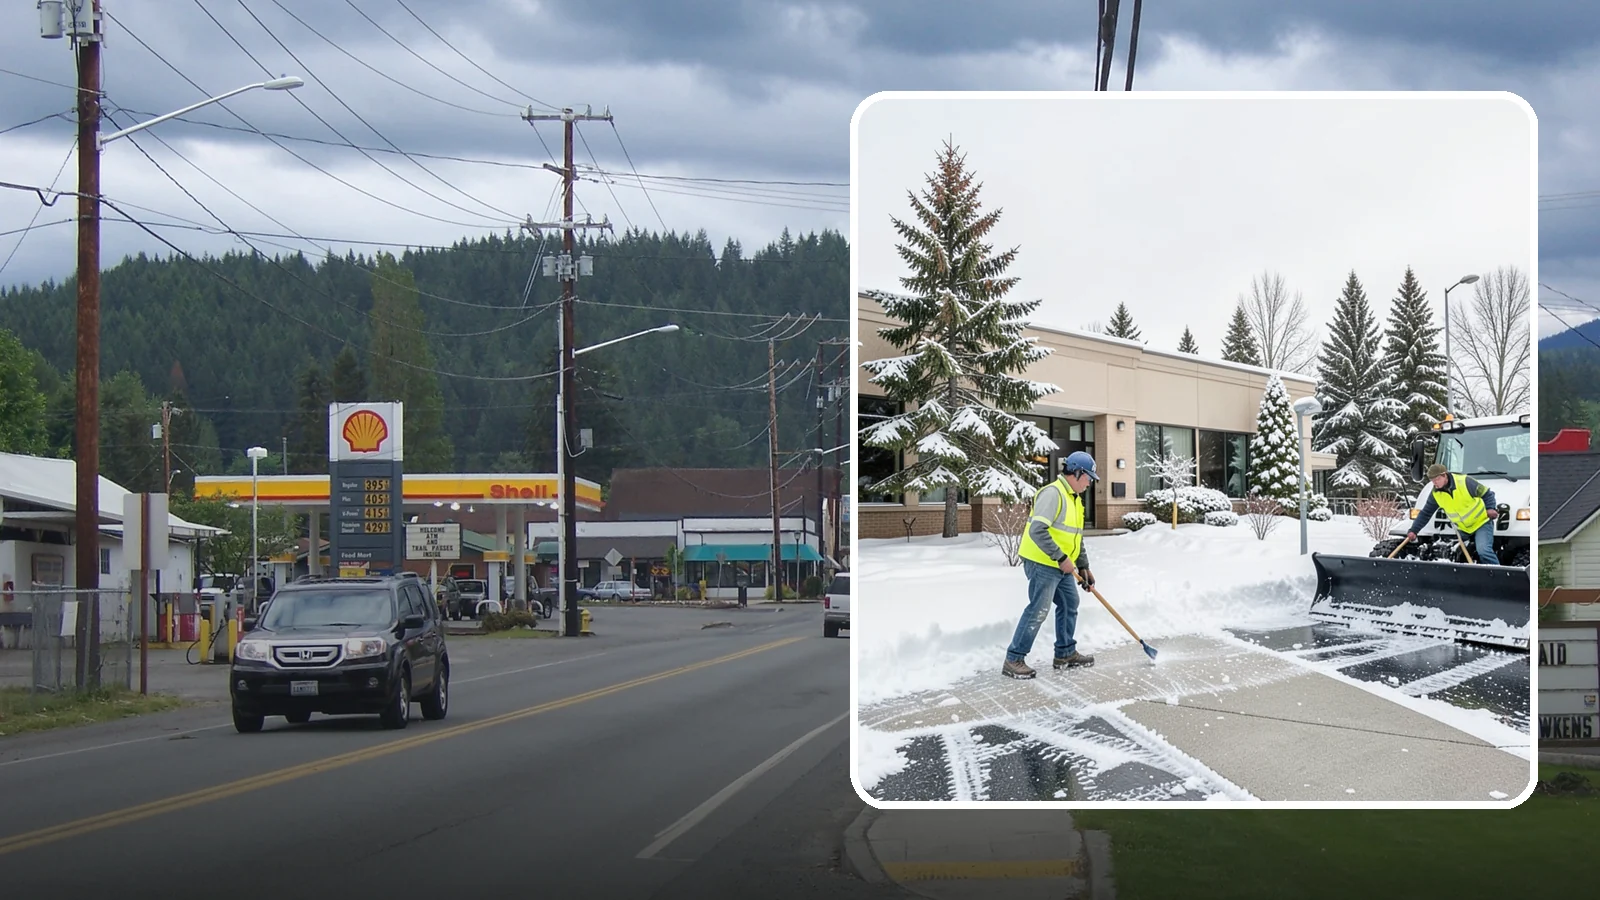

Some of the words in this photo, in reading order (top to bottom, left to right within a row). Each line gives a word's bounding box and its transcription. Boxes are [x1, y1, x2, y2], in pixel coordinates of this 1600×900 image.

[366, 480, 384, 490] 395
[490, 484, 548, 499] Shell
[366, 494, 384, 504] 405
[366, 508, 384, 518] 415
[366, 522, 384, 532] 429
